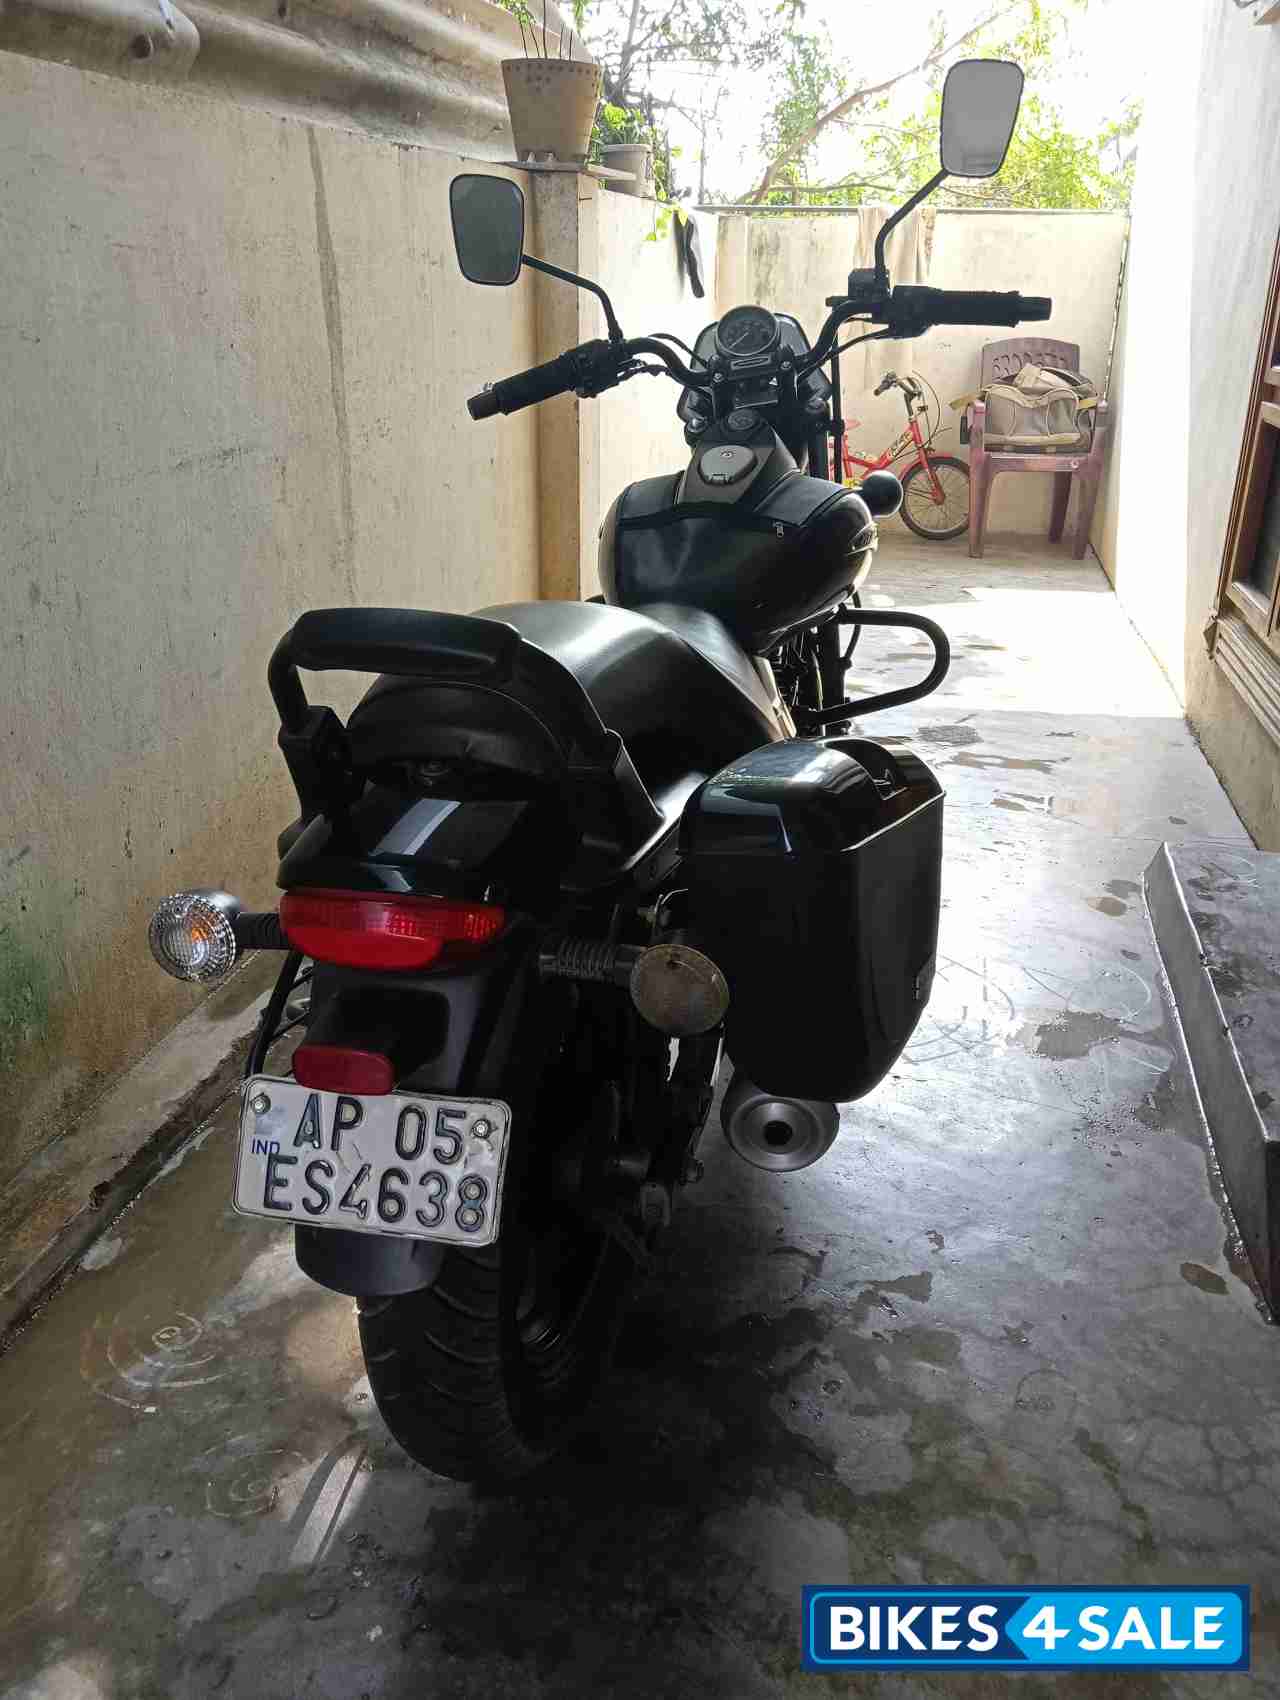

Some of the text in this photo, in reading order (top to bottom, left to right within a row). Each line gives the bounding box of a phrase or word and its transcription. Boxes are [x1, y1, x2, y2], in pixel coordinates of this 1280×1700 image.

[252, 1138, 280, 1155] IND
[294, 1093, 467, 1165] AP 05
[263, 1152, 488, 1233] ES4638
